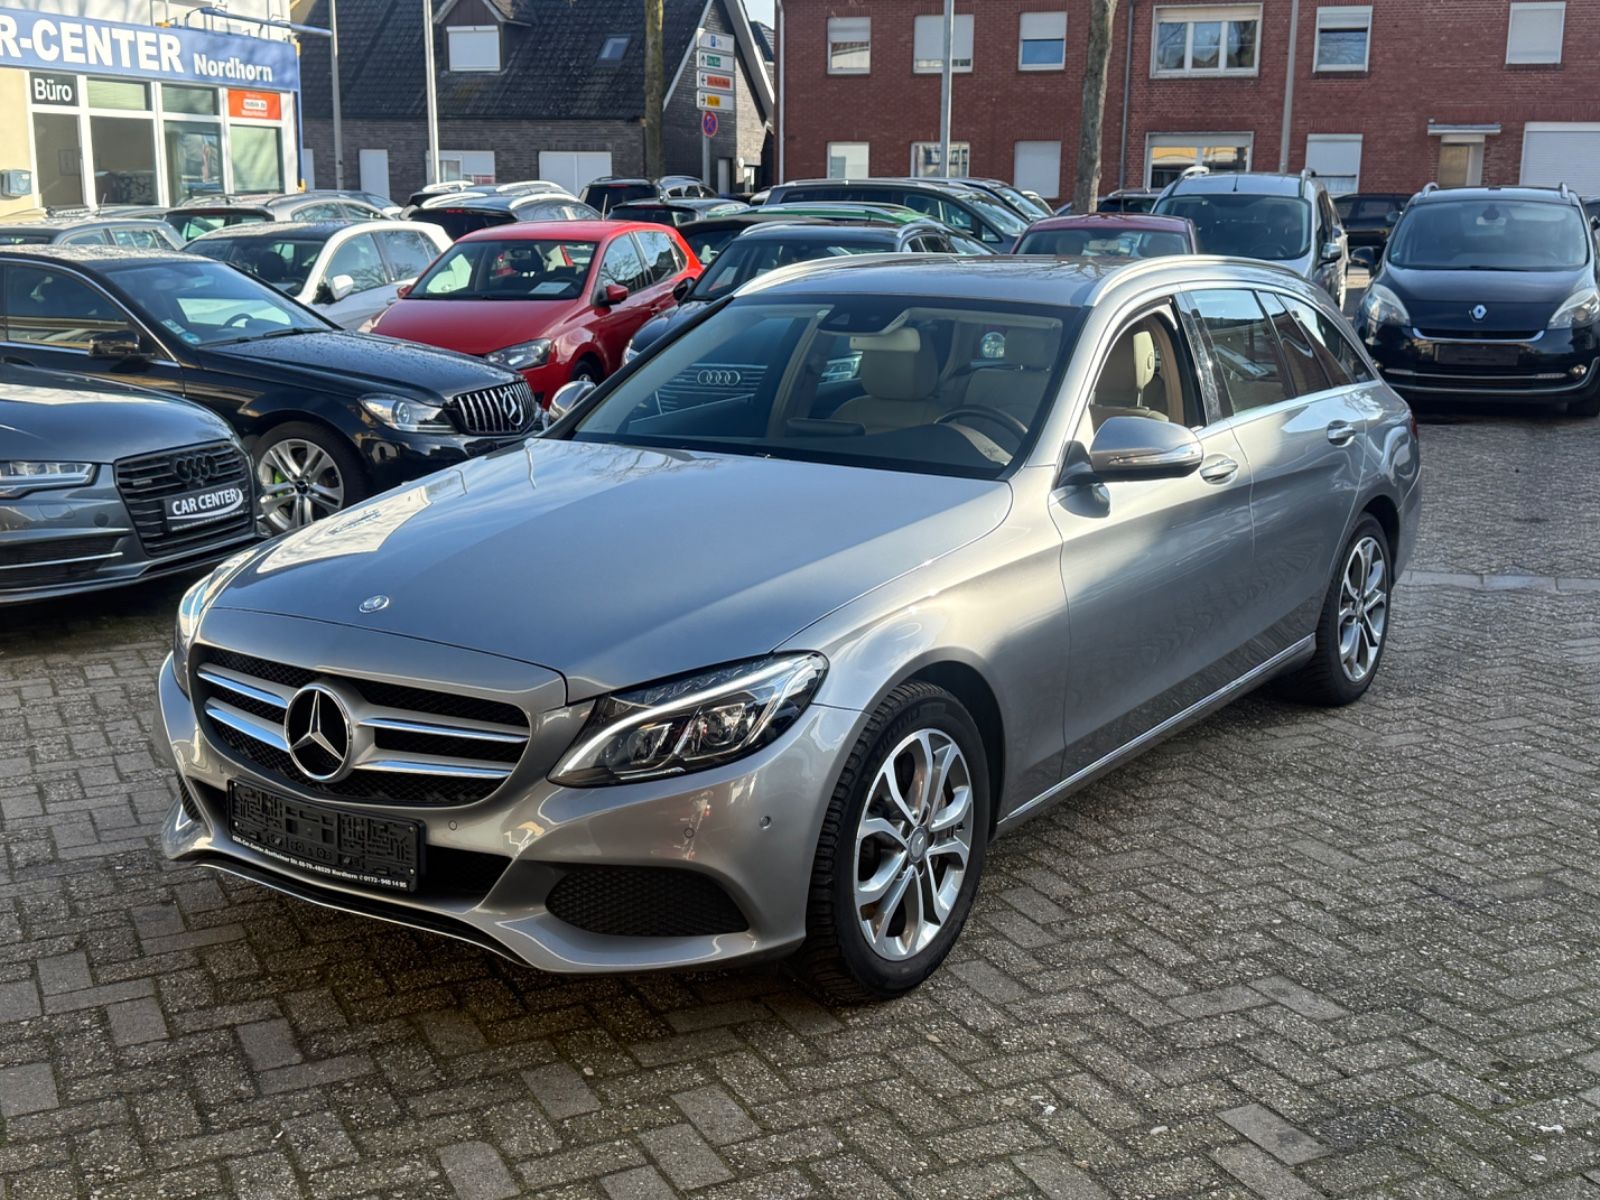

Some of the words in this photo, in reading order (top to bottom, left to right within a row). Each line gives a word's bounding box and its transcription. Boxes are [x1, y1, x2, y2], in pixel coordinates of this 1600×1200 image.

[193, 53, 273, 82] Nordhorn
[34, 78, 72, 101] Büro
[172, 498, 197, 515] CAR
[198, 488, 237, 509] CENTER
